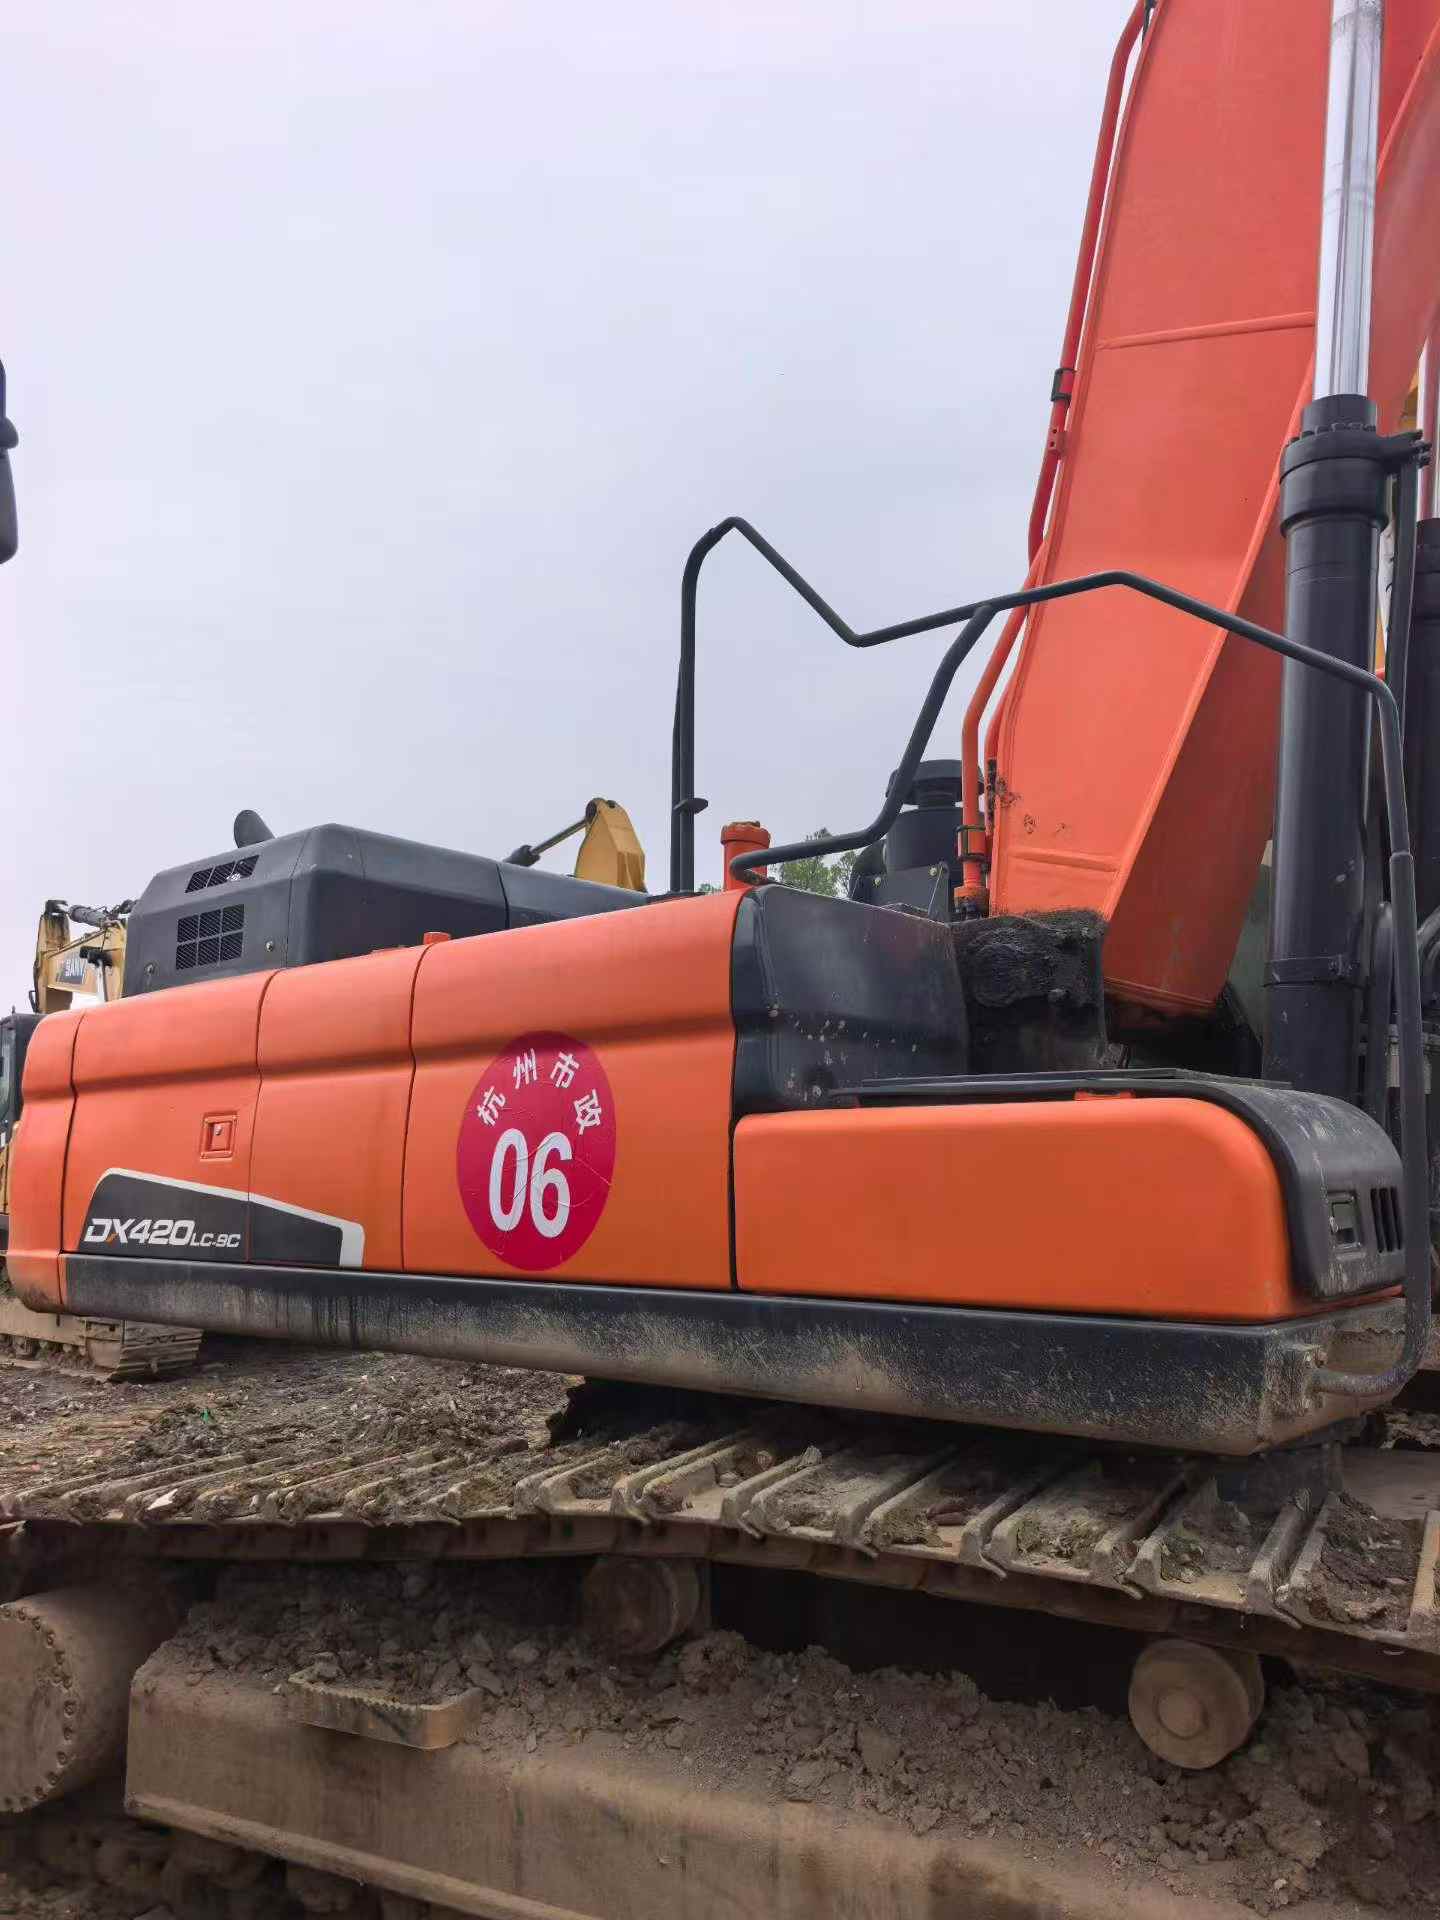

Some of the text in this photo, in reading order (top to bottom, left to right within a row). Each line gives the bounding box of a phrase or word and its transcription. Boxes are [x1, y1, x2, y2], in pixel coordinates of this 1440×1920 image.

[477, 1048, 602, 1135] 杭州市政
[488, 1128, 573, 1238] 06
